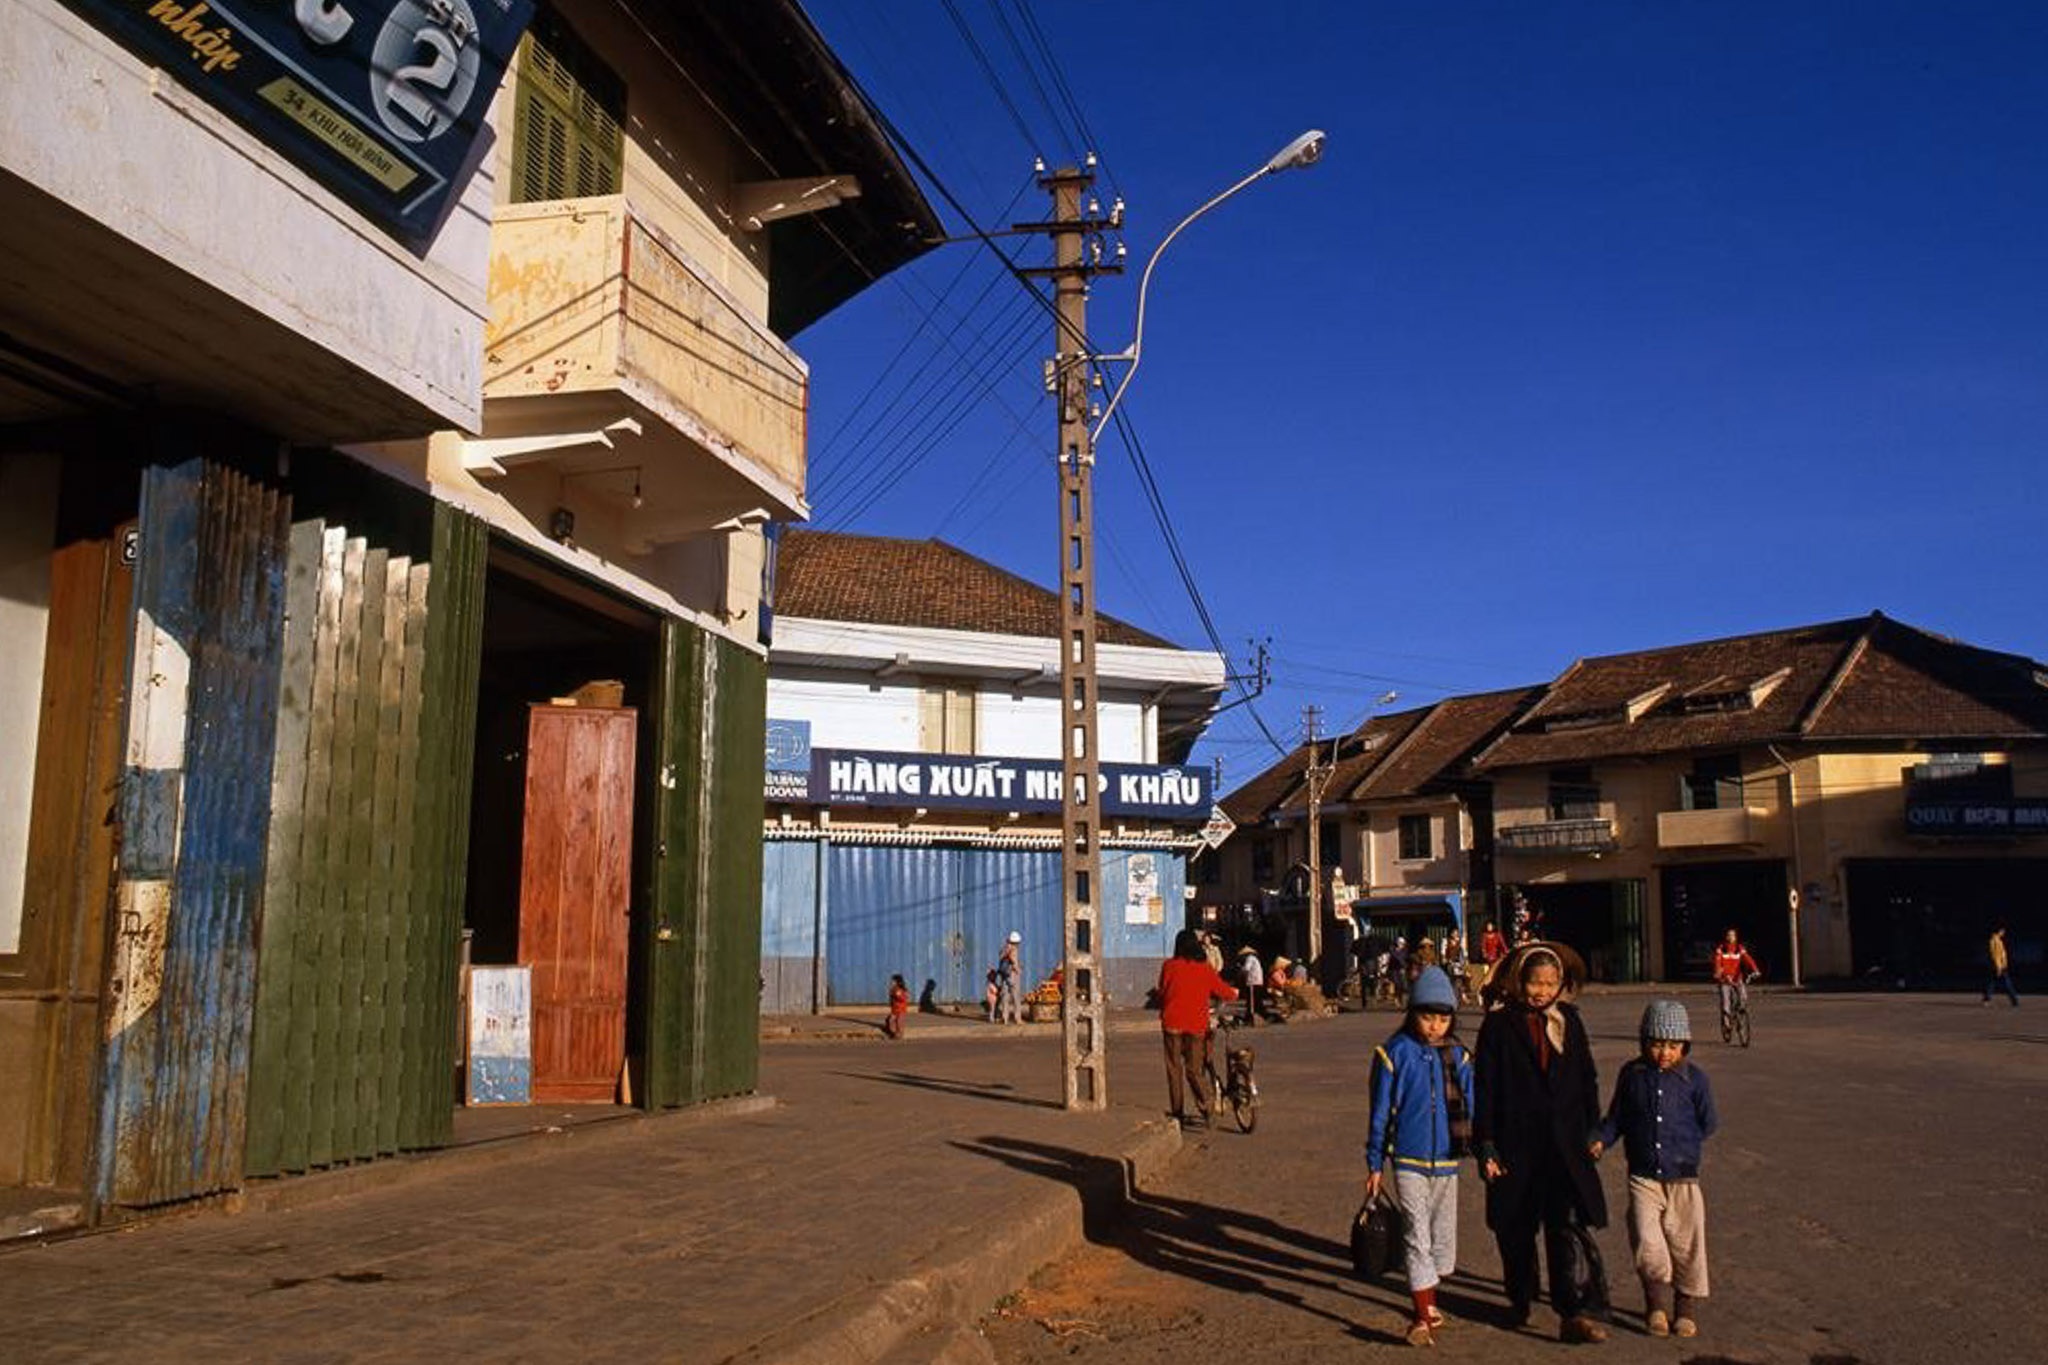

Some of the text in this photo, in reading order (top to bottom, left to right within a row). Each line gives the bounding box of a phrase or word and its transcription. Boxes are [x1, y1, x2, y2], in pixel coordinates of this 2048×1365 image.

[830, 756, 920, 796] HÀNG
[929, 761, 1016, 798] XUẤT
[1120, 768, 1200, 806] KHẨU
